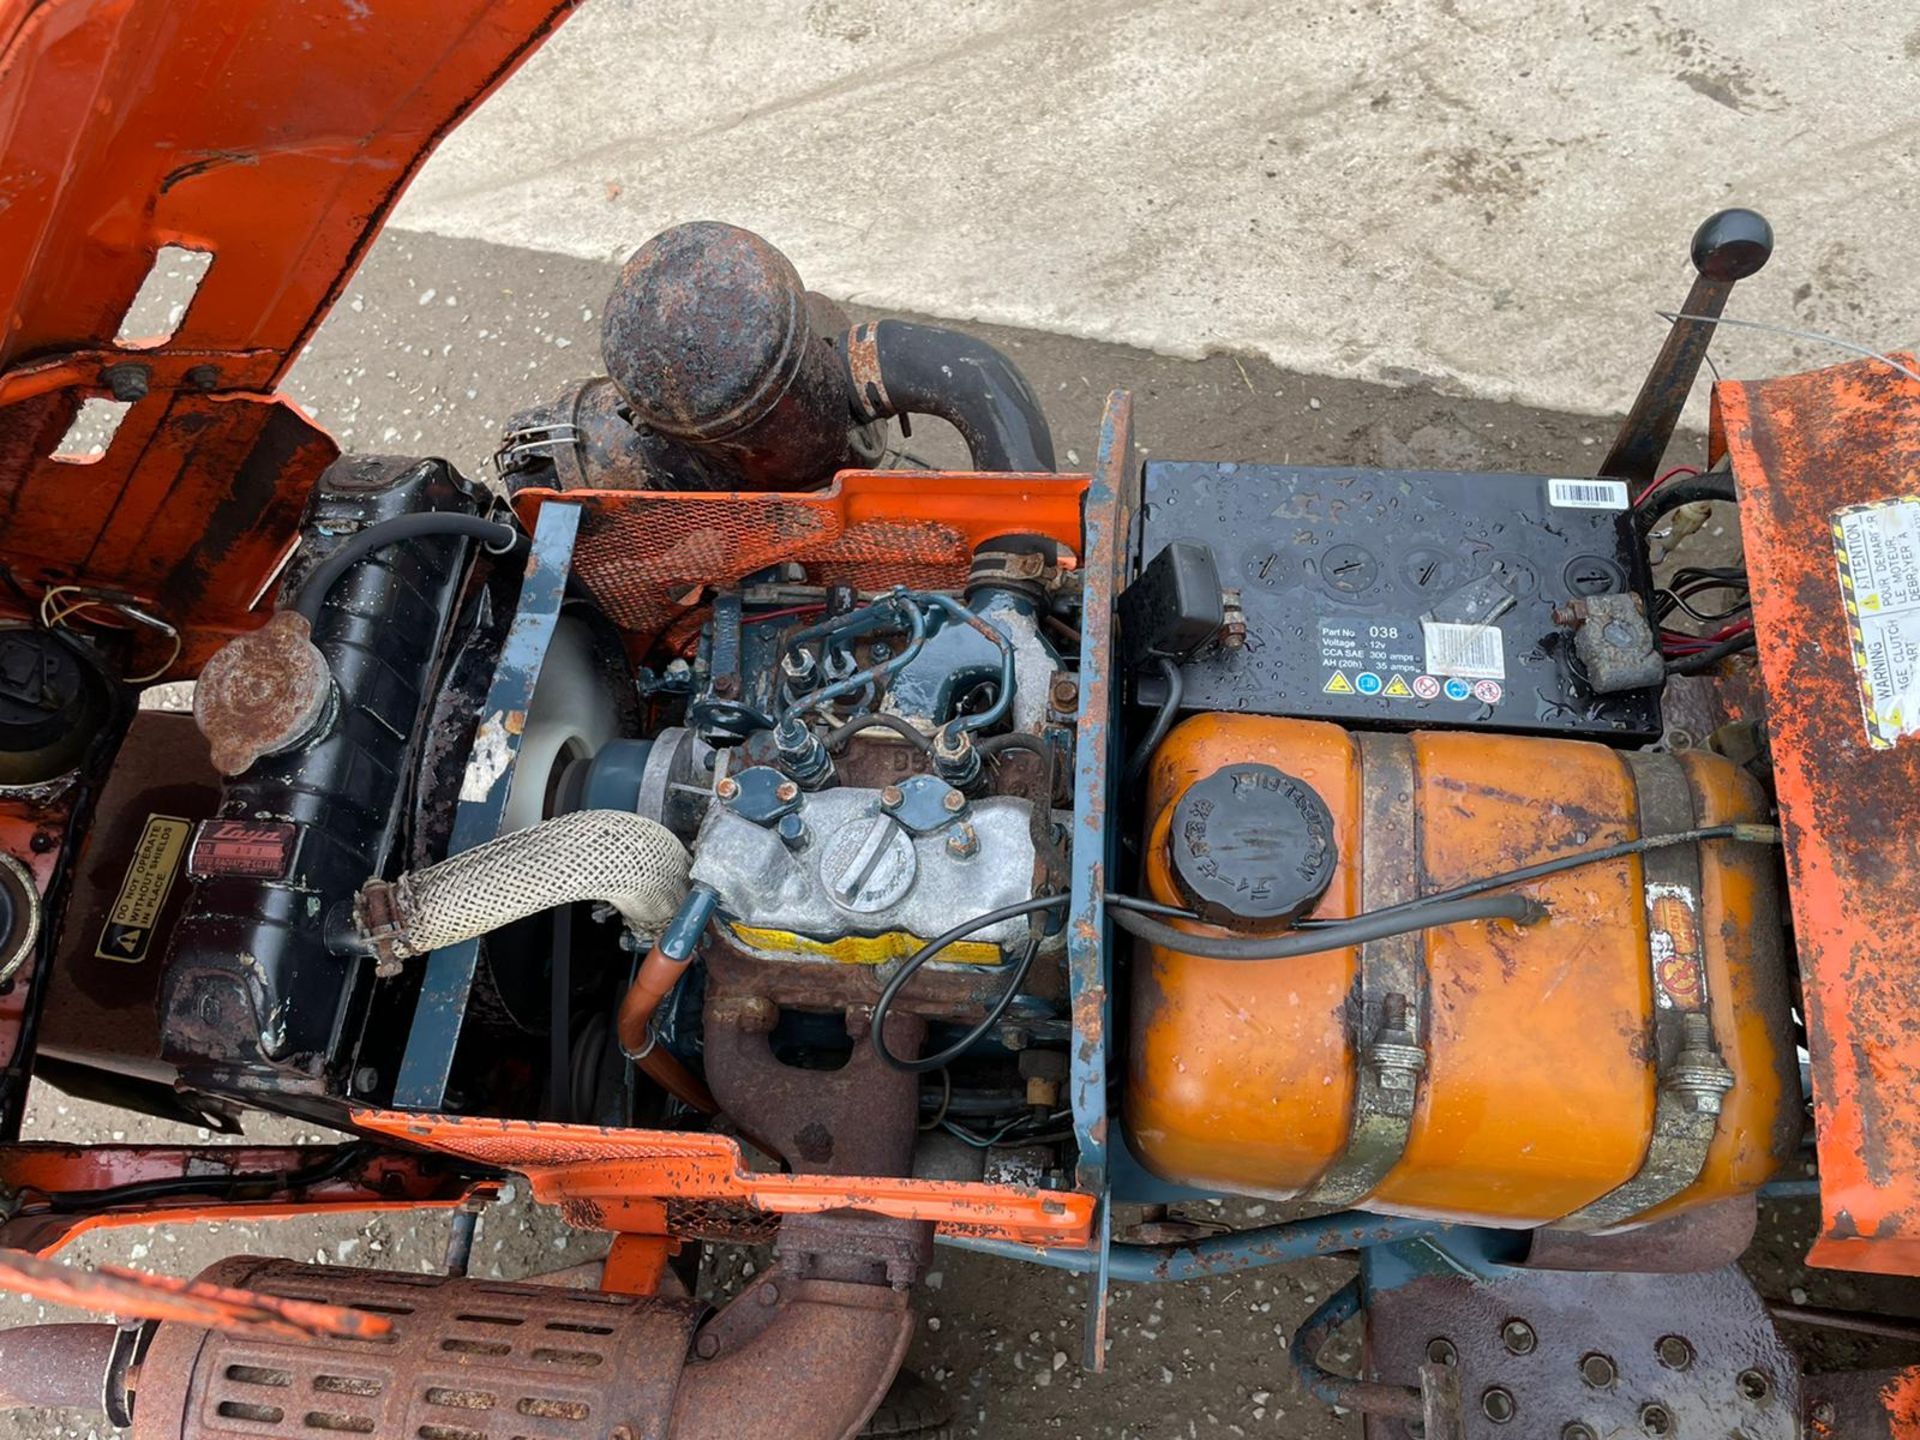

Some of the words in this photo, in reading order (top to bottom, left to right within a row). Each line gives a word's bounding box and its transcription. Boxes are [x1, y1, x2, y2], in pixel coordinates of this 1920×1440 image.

[1846, 523, 1870, 589] ATTENTION
[1879, 577, 1894, 606] POUR
[1895, 589, 1907, 604] LE
[1322, 628, 1340, 637] Part
[1342, 628, 1355, 637] No
[1369, 626, 1398, 639] 038
[1322, 638, 1356, 648] Voltage
[1369, 641, 1386, 649] 12v
[1887, 619, 1905, 663] CLUTCH
[1322, 649, 1343, 657] CCA
[1345, 649, 1365, 658] SAE
[1369, 651, 1387, 660] 300
[1322, 659, 1337, 667] AH
[1375, 662, 1388, 670] 35
[1868, 641, 1892, 700] WARNING
[117, 904, 129, 920] DO
[126, 879, 139, 900] NOT
[136, 825, 161, 873] OPERATE
[129, 872, 154, 922] WITHOUT
[149, 827, 172, 869] SHIELDS
[141, 913, 151, 924] IN
[148, 873, 166, 908] PLACE
